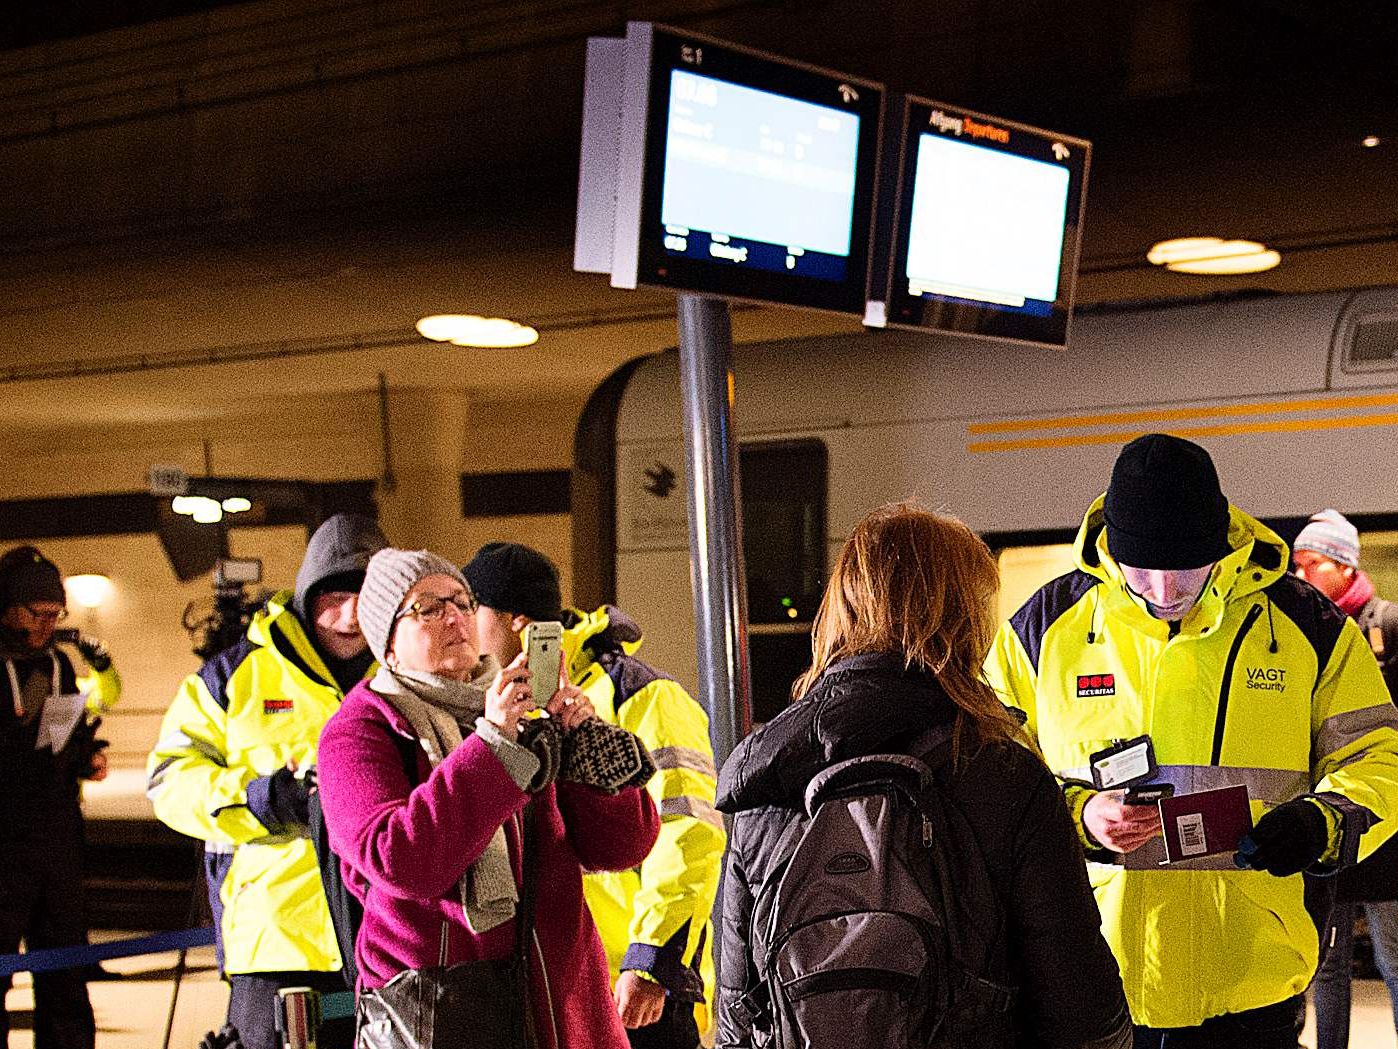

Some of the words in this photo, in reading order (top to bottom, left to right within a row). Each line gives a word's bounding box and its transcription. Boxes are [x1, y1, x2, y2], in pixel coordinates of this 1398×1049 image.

[1246, 667, 1286, 681] VAGT
[1078, 688, 1114, 696] SECURITAS
[1246, 680, 1286, 693] Security
